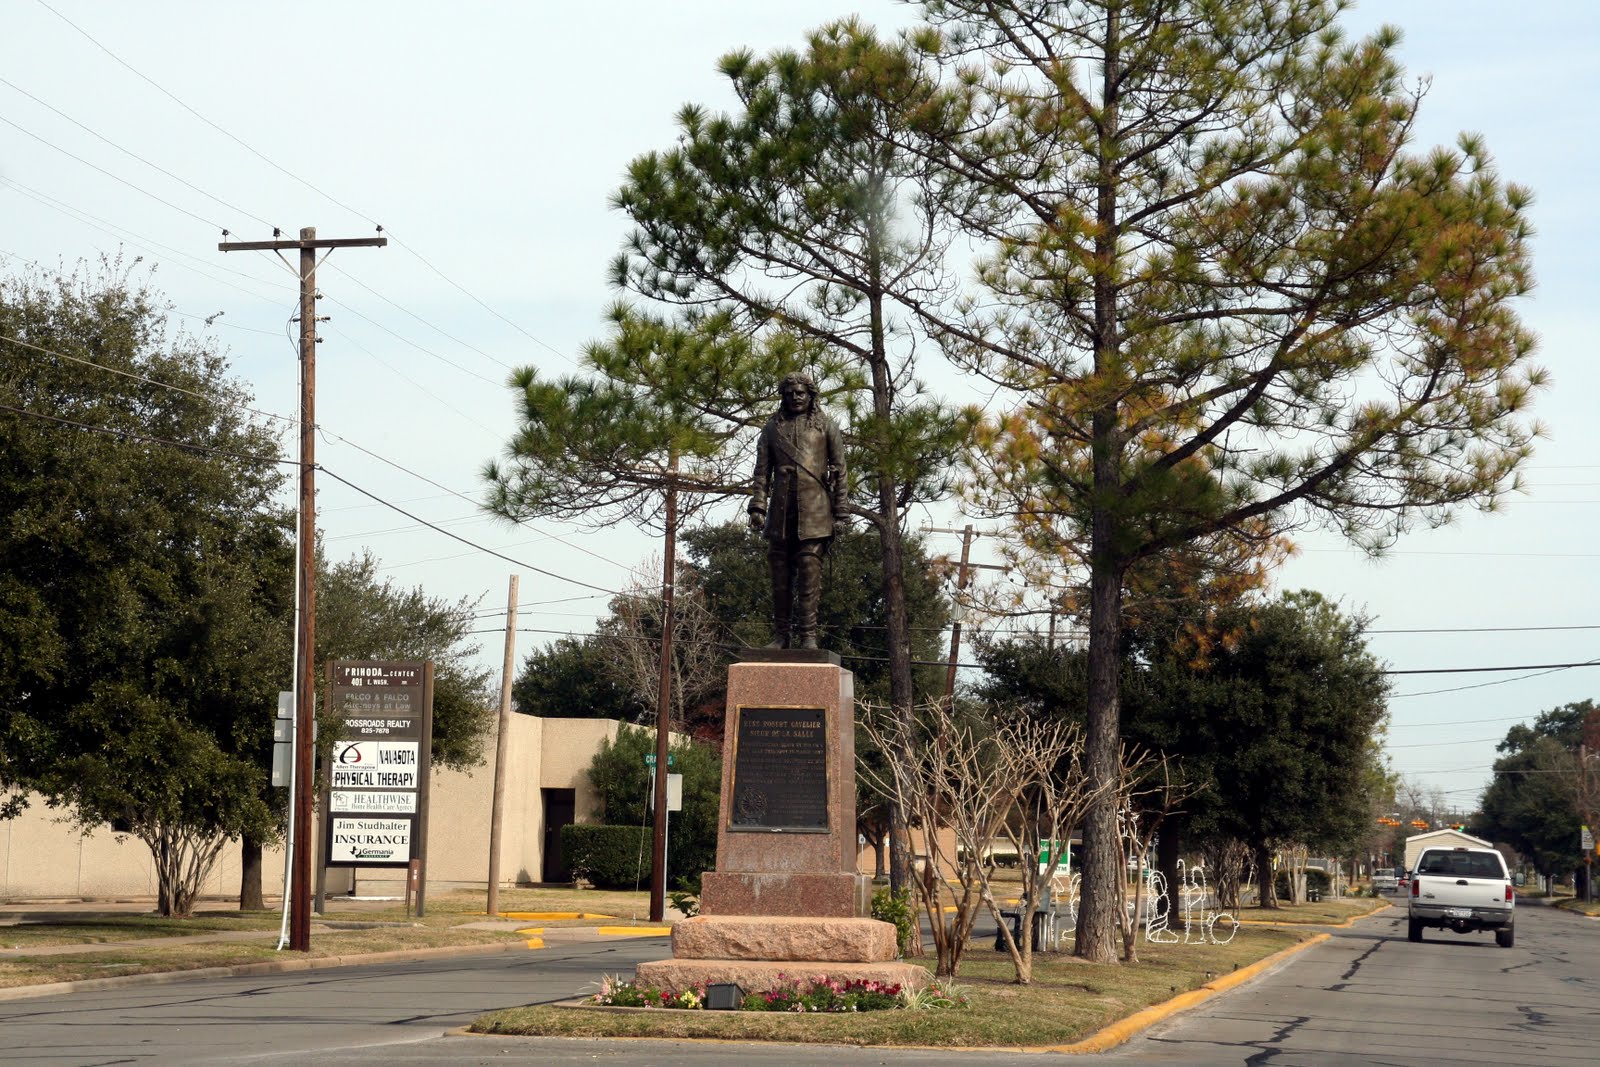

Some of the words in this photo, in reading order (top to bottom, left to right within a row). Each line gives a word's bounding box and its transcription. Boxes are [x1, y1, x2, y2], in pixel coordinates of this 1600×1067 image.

[345, 668, 382, 676] PRIHODA
[351, 678, 362, 686] 401
[380, 750, 415, 764] NAVASOTA
[335, 772, 374, 786] PHYSICAL
[377, 772, 414, 786] THERAPY
[354, 794, 412, 804] HEALTHWISE
[337, 821, 354, 829] Jim
[357, 821, 407, 830] Studhalter
[335, 834, 408, 844] INSURANCE
